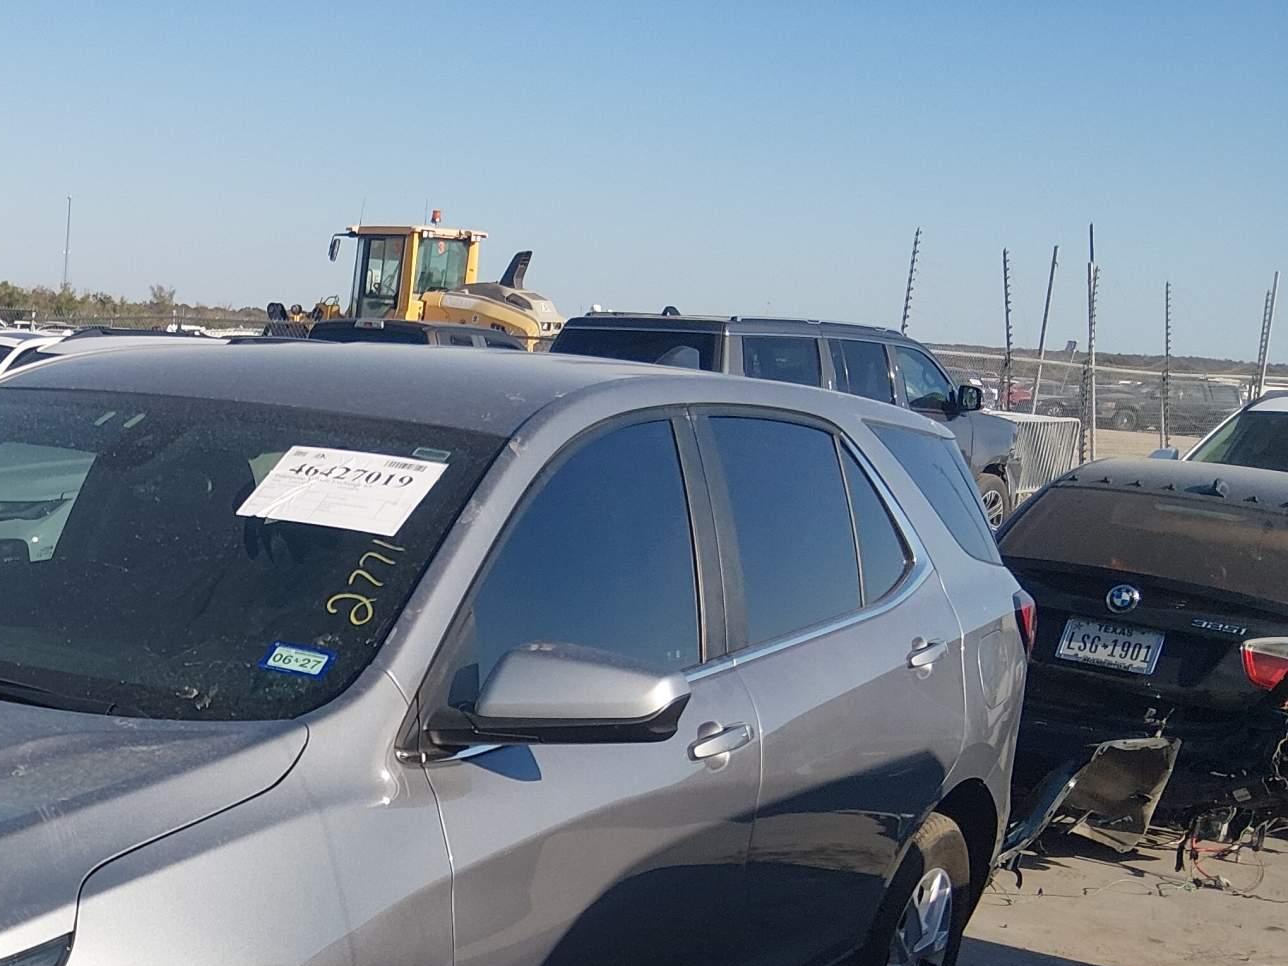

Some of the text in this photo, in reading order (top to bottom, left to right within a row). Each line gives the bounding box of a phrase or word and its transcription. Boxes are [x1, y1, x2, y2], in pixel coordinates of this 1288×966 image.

[289, 463, 414, 488] 46427019
[326, 538, 406, 625] 2771
[1098, 623, 1133, 637] TEXAS
